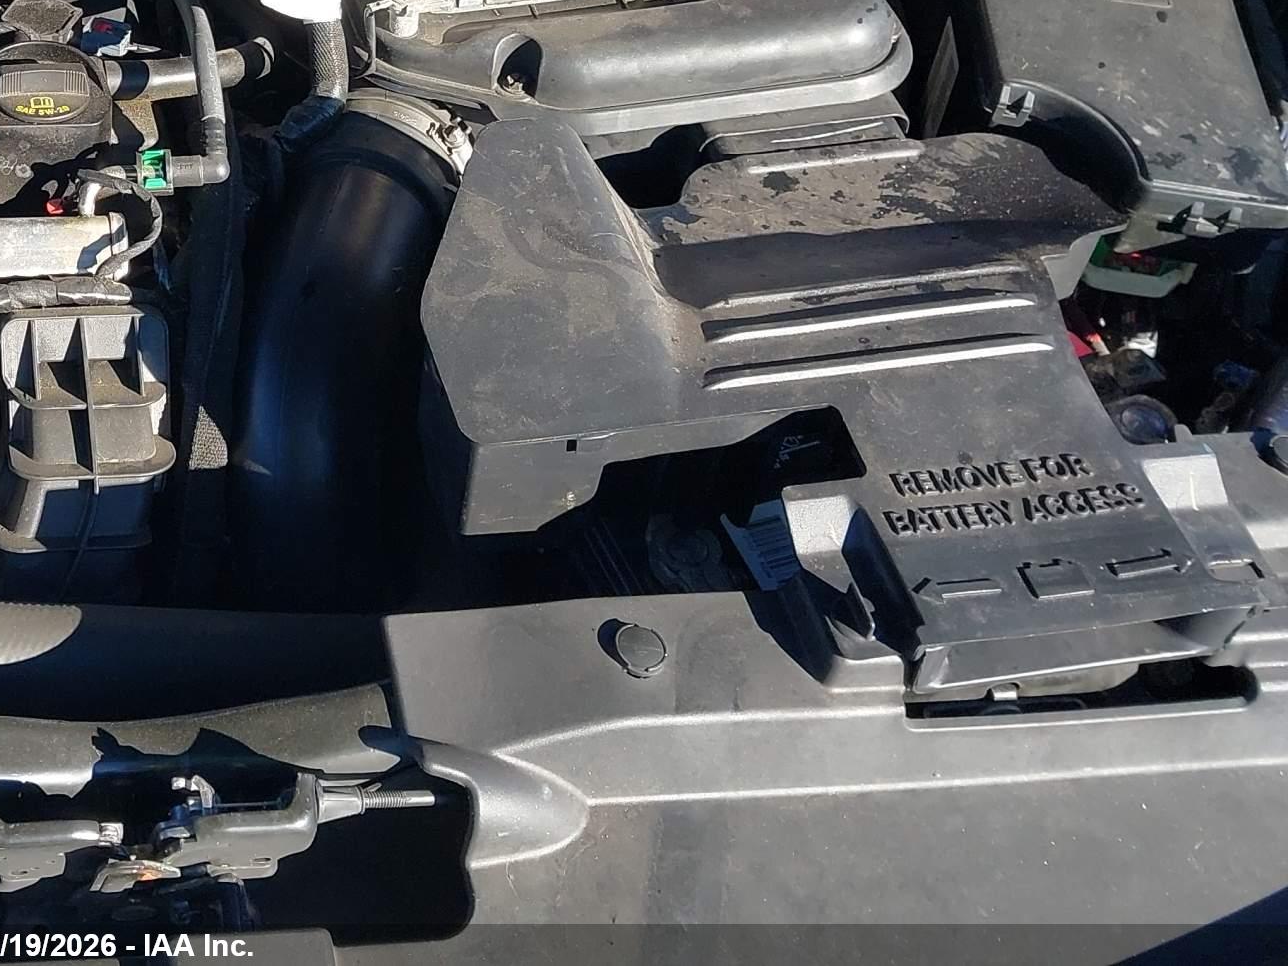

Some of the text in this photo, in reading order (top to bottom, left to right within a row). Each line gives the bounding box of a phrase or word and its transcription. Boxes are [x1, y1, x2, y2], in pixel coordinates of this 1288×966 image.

[15, 105, 70, 116] SAE 5W-20
[889, 454, 1094, 497] REMOVE FOR
[882, 483, 1145, 536] BATTERY ACCESS
